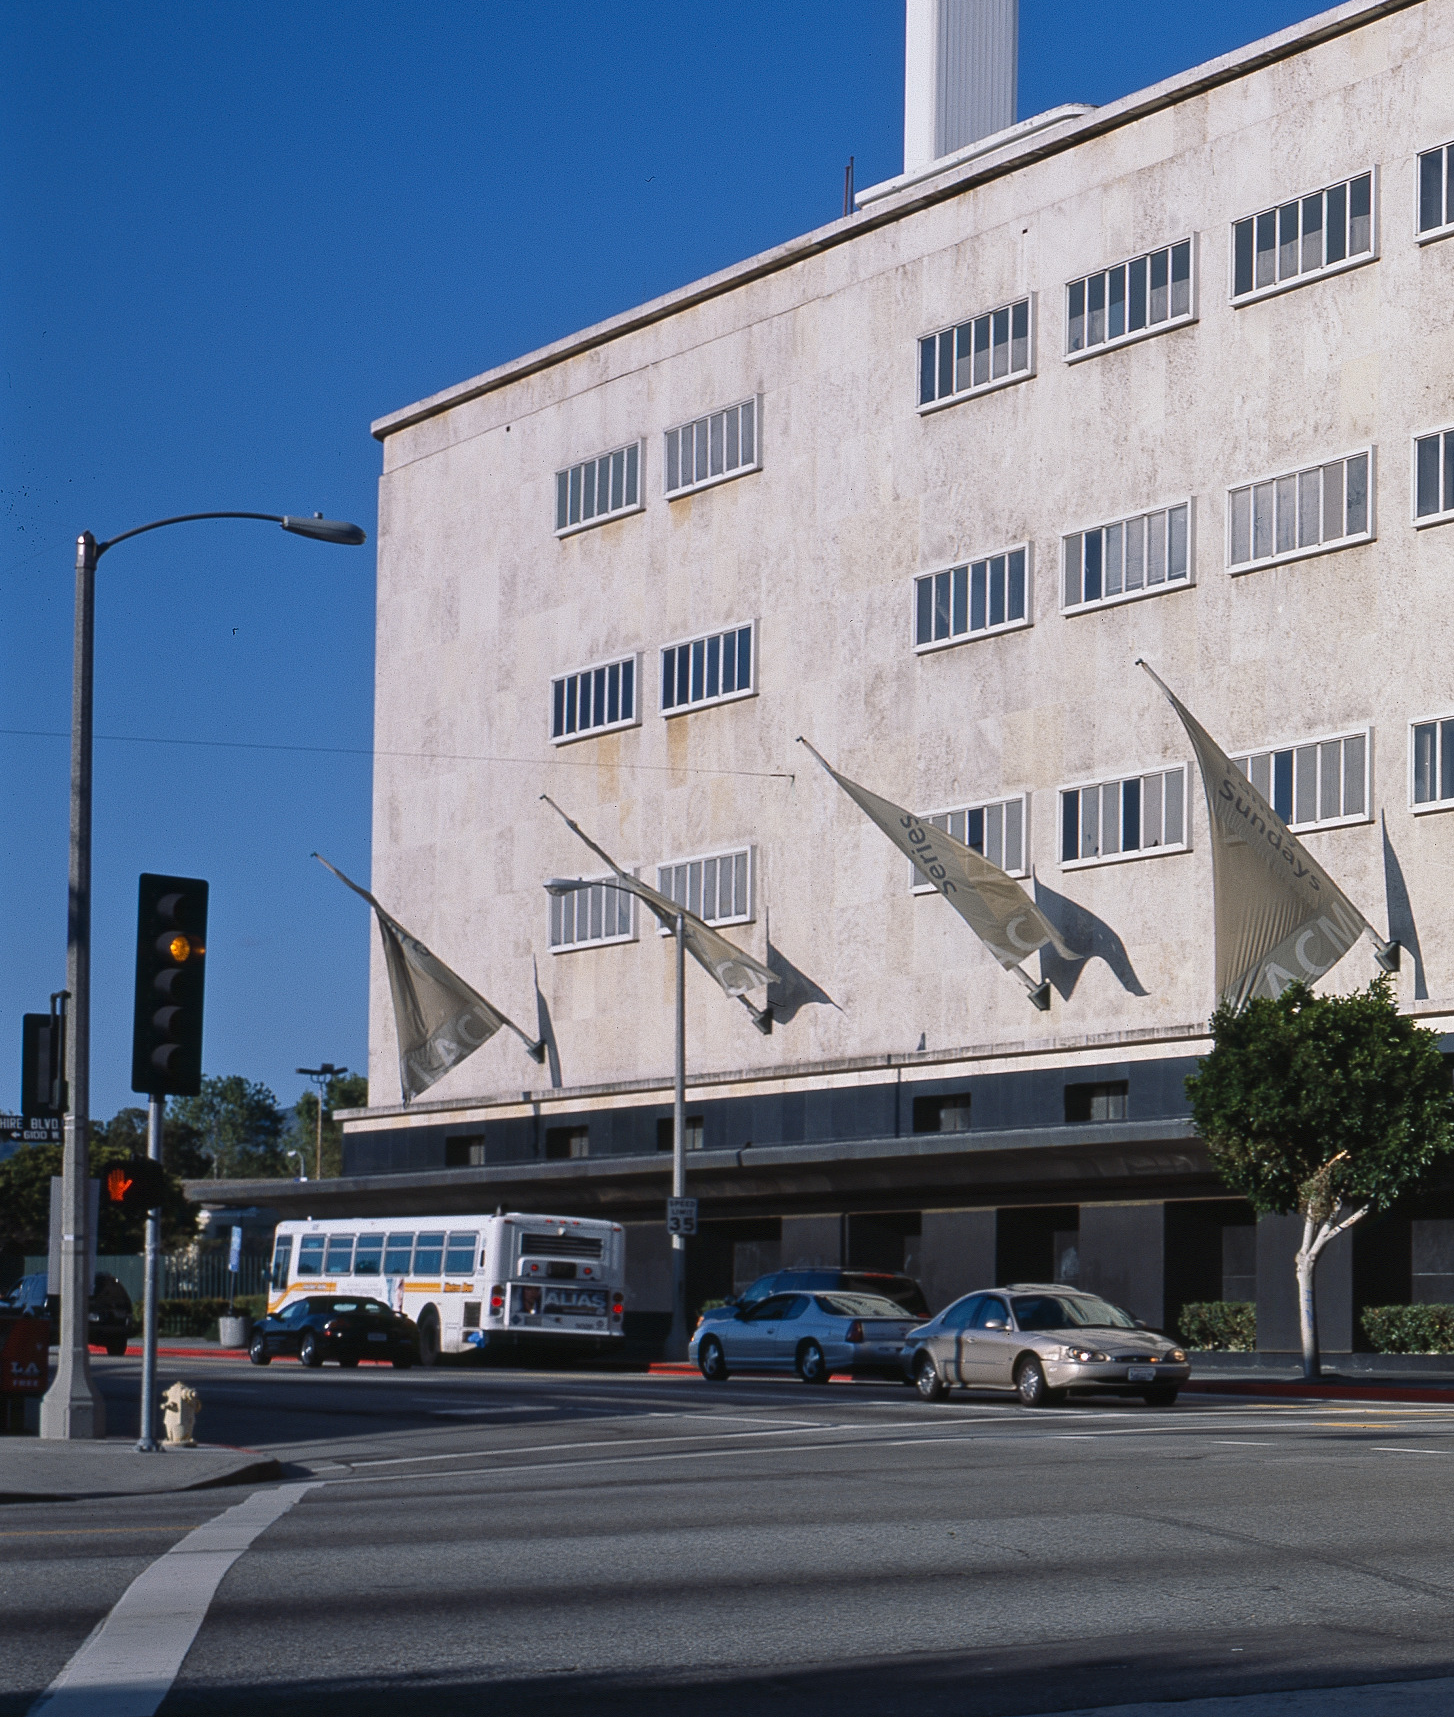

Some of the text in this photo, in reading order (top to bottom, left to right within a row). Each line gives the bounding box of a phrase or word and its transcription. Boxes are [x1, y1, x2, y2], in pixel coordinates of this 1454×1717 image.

[1218, 779, 1322, 892] Sundays
[900, 815, 958, 895] Series
[30, 1117, 59, 1130] BLVD
[23, 1130, 48, 1140] 6100
[669, 1200, 696, 1208] SPEED
[669, 1217, 695, 1231] 35
[545, 1292, 606, 1308] ALIAS
